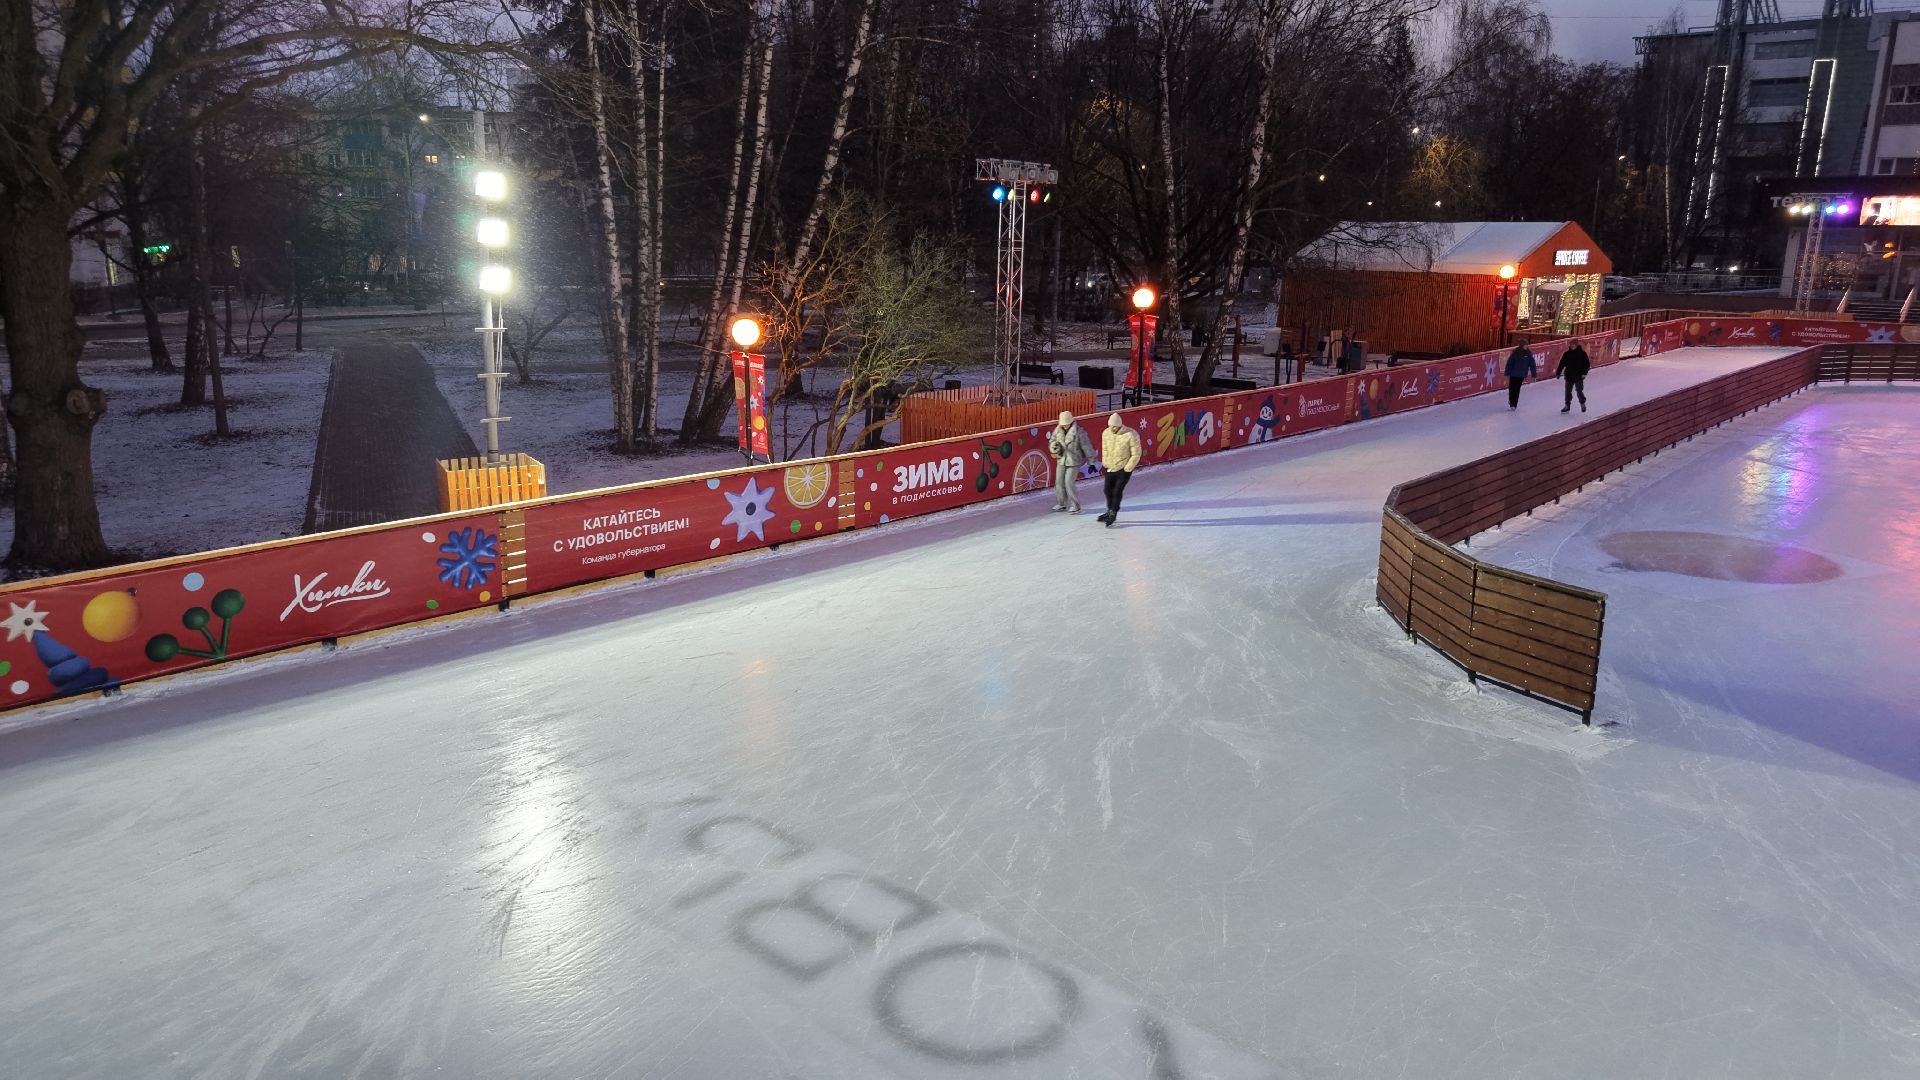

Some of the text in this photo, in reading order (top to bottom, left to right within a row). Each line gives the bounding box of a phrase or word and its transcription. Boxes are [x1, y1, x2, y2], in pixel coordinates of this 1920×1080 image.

[583, 508, 661, 531] КАТАЙТЕСЬ
[553, 517, 690, 553] С УДОВОЛЬСТВИЕМ!
[582, 543, 666, 565] Команда губернатора
[280, 560, 391, 622] Химки
